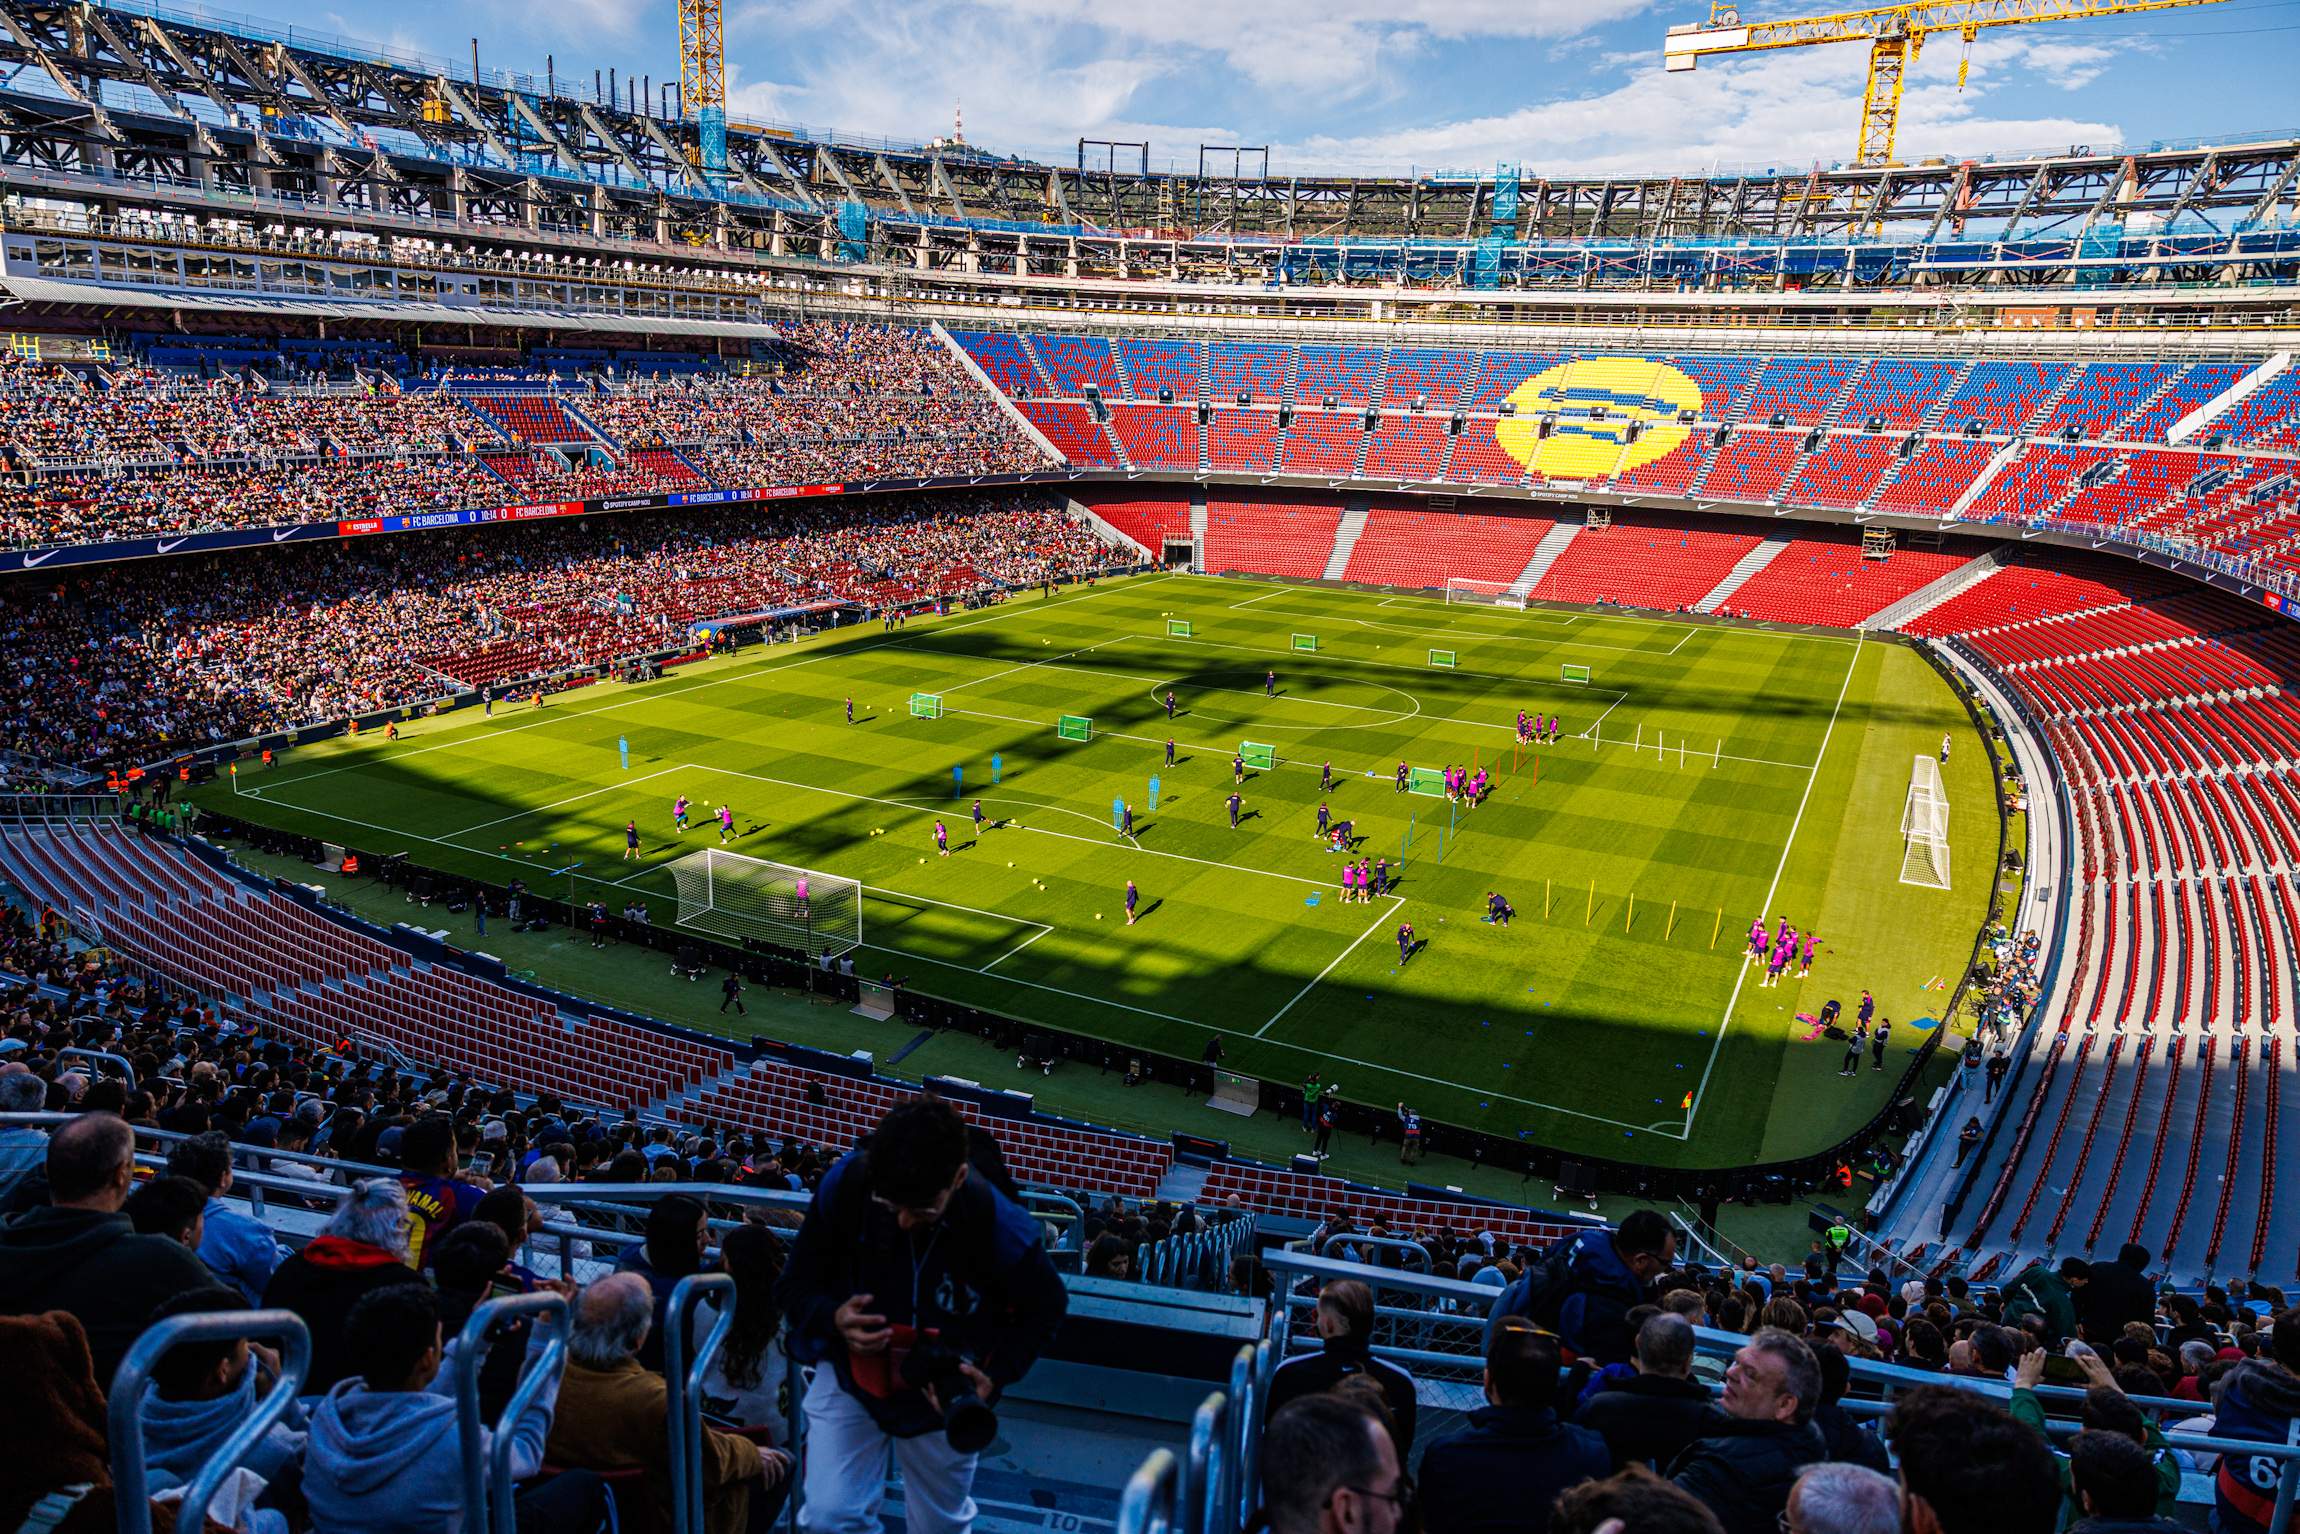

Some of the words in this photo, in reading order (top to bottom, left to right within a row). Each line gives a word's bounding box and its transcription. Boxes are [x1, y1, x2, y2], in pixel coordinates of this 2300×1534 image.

[690, 494, 697, 503] FC
[697, 492, 725, 502] BARCELONA
[731, 490, 737, 500] 0
[755, 489, 760, 498] 0
[766, 489, 773, 498] FC
[773, 487, 798, 497] BARCELONA
[609, 500, 627, 508] SPOTIFY
[627, 499, 640, 507] CAMP
[413, 516, 422, 527] FC
[422, 513, 459, 526] BARCELONA
[469, 511, 476, 522] 0
[481, 510, 497, 520] 10:14
[501, 508, 507, 519] 0
[516, 507, 523, 517] FC
[524, 504, 557, 516] BARCELONA
[352, 522, 378, 531] ESTRELLA
